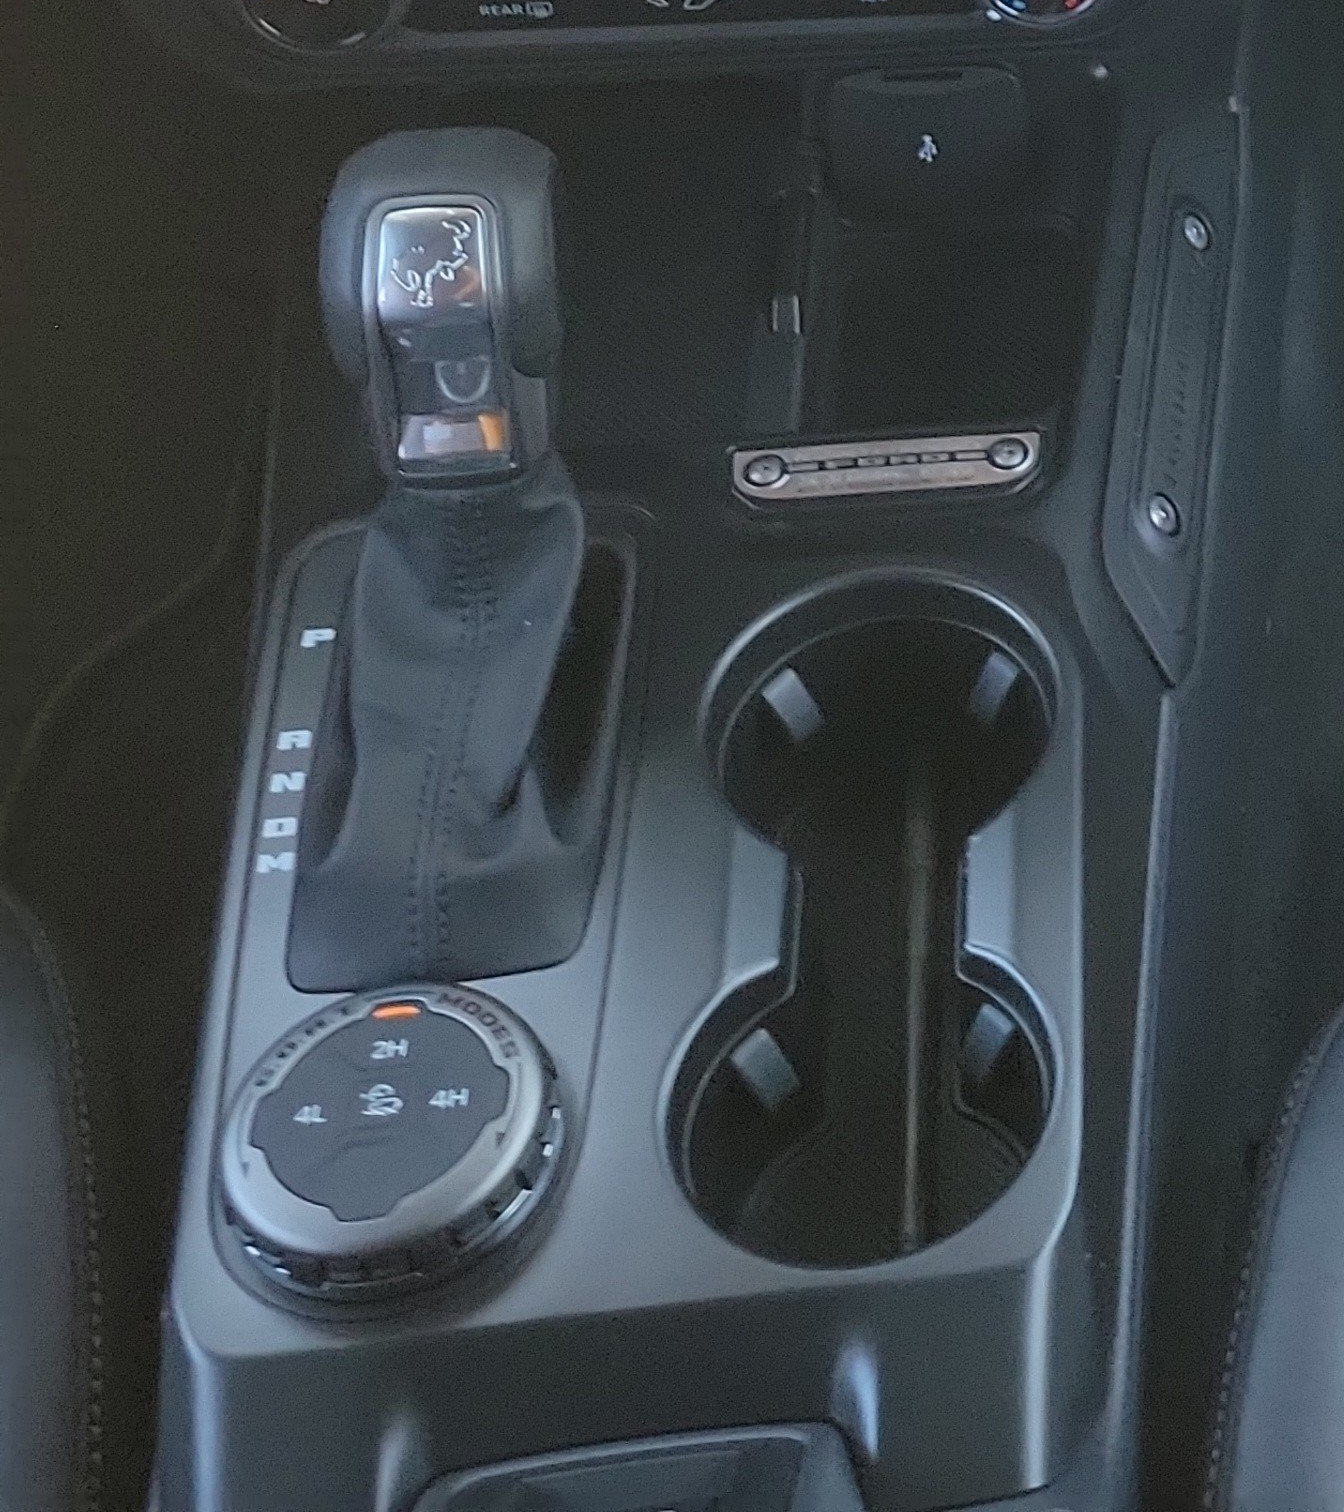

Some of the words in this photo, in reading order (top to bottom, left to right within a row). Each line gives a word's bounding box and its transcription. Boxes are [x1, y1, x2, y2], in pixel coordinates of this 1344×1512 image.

[479, 3, 524, 16] REAR
[301, 627, 337, 648] P
[270, 771, 307, 793] N
[371, 1039, 410, 1060] 2H
[428, 1088, 469, 1109] 4H
[293, 1104, 328, 1125] 4L
